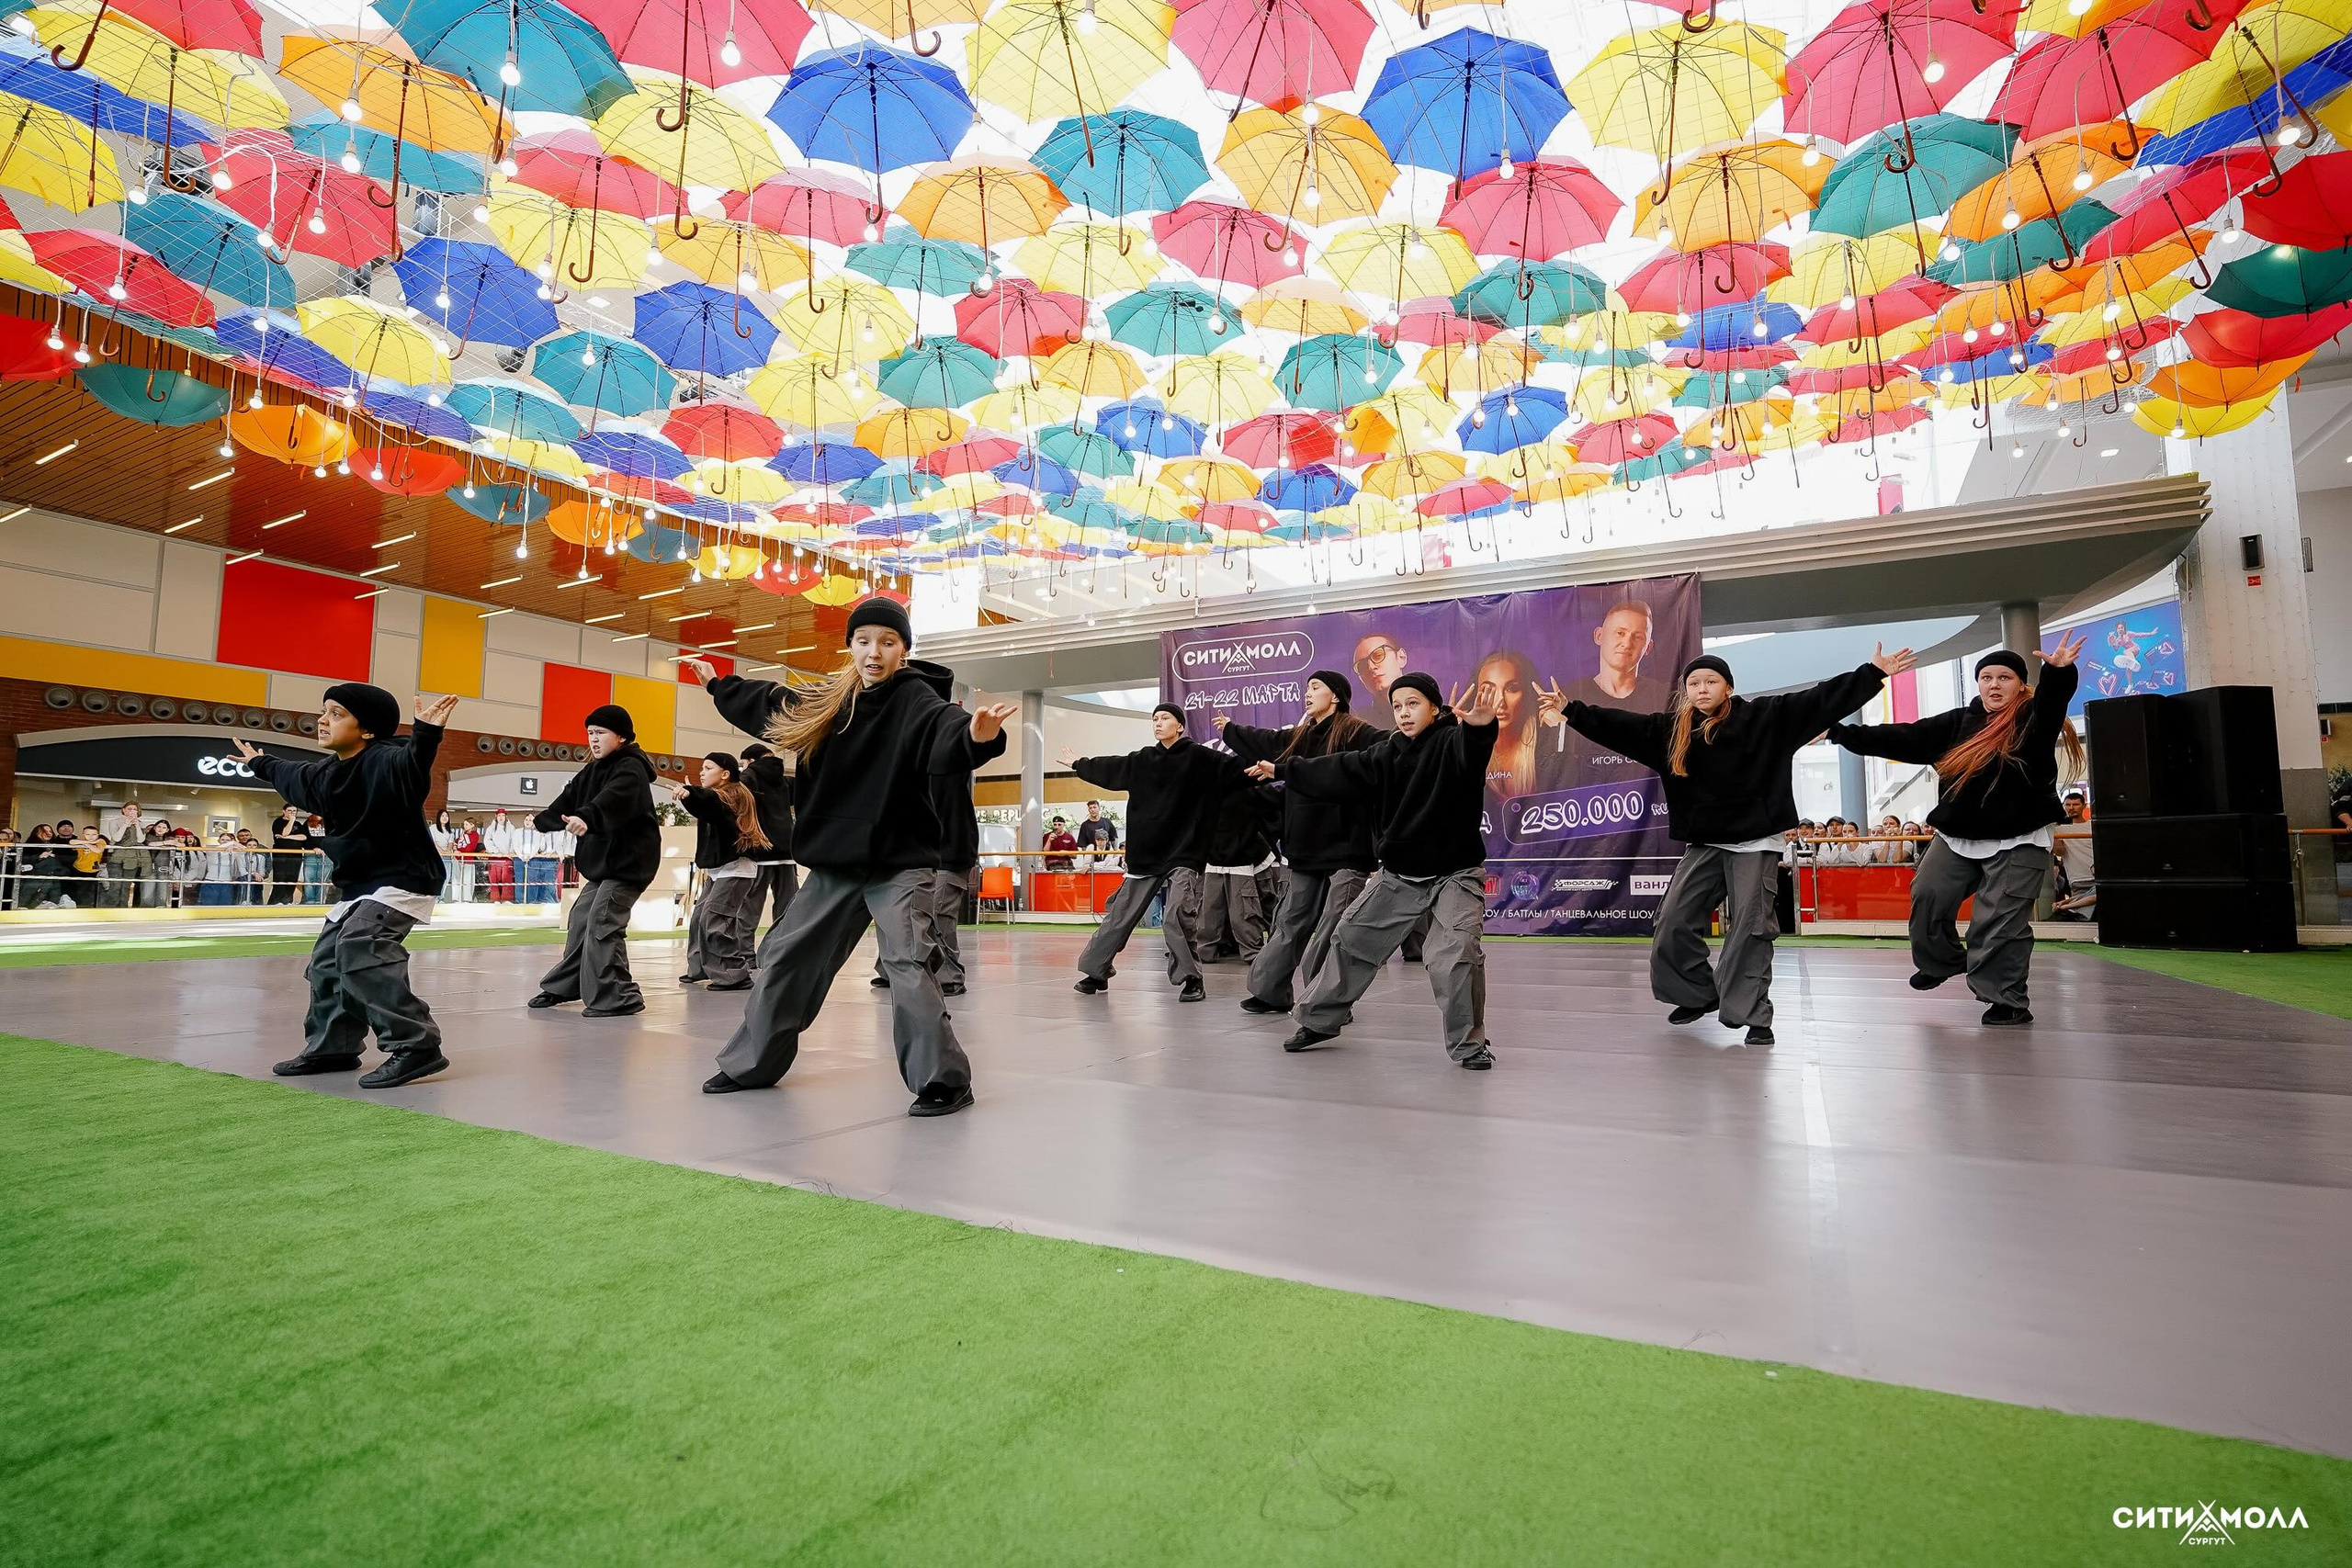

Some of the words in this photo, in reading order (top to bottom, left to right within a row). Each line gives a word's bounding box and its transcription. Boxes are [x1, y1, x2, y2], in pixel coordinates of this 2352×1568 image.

[1227, 665, 1250, 673] СУРГУТ
[1183, 689, 1239, 711] 21-22
[1242, 682, 1301, 706] МАРТА
[1592, 755, 1623, 765] ИГОРЬ
[1486, 771, 1513, 780] ДИНА
[1521, 790, 1645, 835] 250.000
[1508, 909, 1543, 919] БАТТЛЫ
[1550, 909, 1627, 919] ТАНЦЕВАЛЬНОЕ
[1629, 909, 1655, 919] ШОУ
